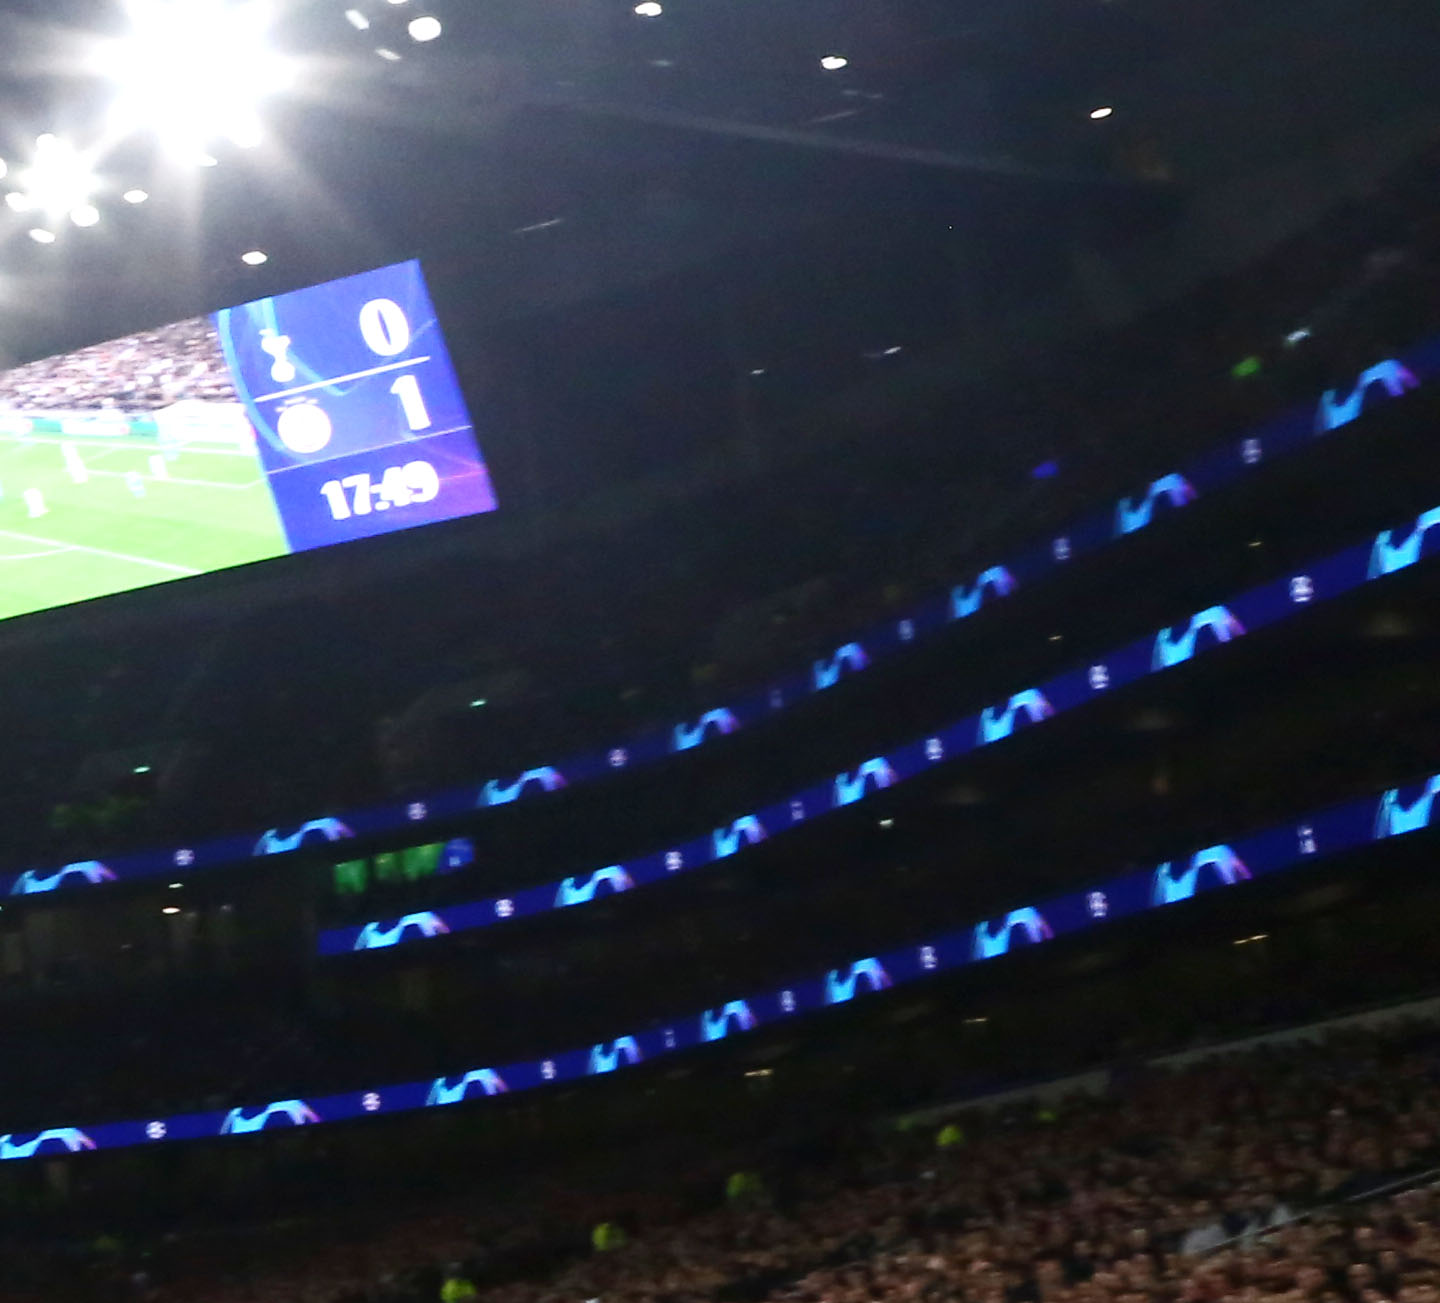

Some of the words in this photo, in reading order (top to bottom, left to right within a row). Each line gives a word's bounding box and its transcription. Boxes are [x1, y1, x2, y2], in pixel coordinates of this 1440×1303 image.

[359, 298, 410, 357] 0
[390, 374, 433, 431] 1
[320, 460, 440, 521] 17:49
